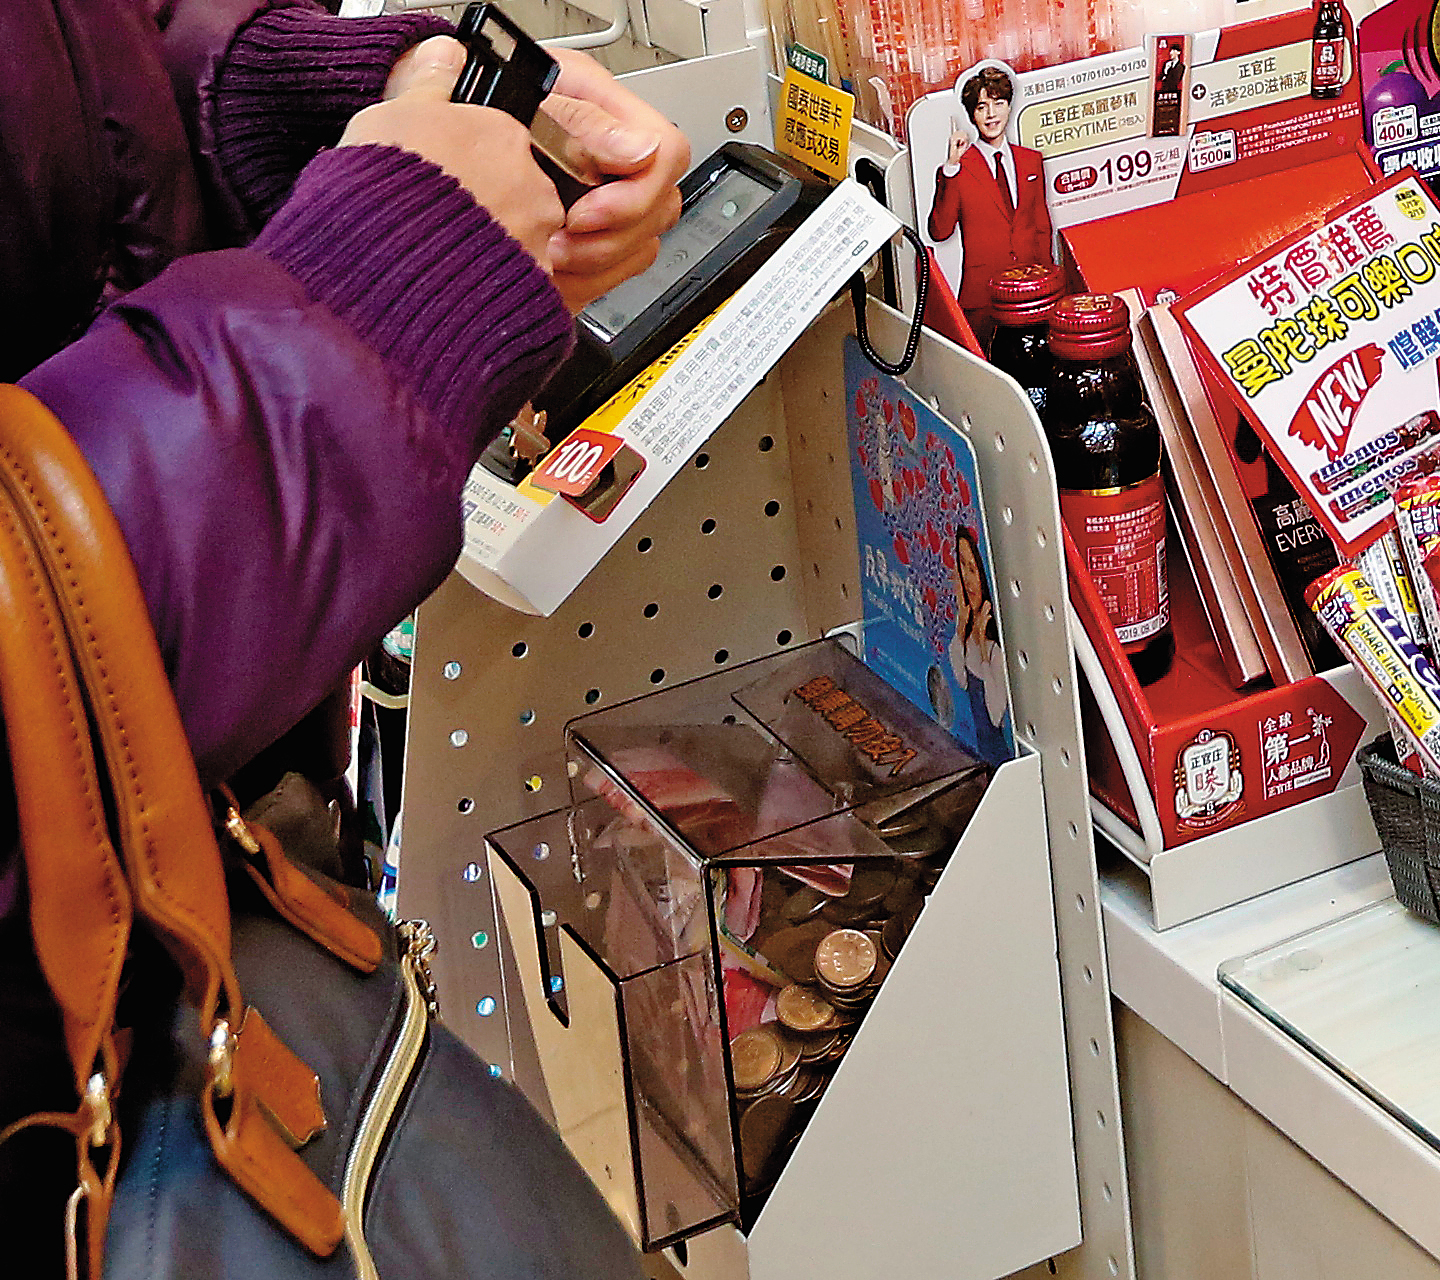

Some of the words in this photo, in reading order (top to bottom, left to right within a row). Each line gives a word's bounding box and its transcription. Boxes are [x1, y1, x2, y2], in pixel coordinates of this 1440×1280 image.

[1238, 57, 1277, 80] 正官庄
[788, 83, 842, 130] 國泰世華卡
[1034, 117, 1118, 149] EVERYTIME
[1100, 150, 1152, 186] 199
[1248, 204, 1396, 316] 特價推薦
[1308, 352, 1369, 451] NEW
[1319, 430, 1400, 480] mentos
[1339, 457, 1417, 508] mentos
[1264, 711, 1293, 734] 全球
[1264, 732, 1311, 766] 第一
